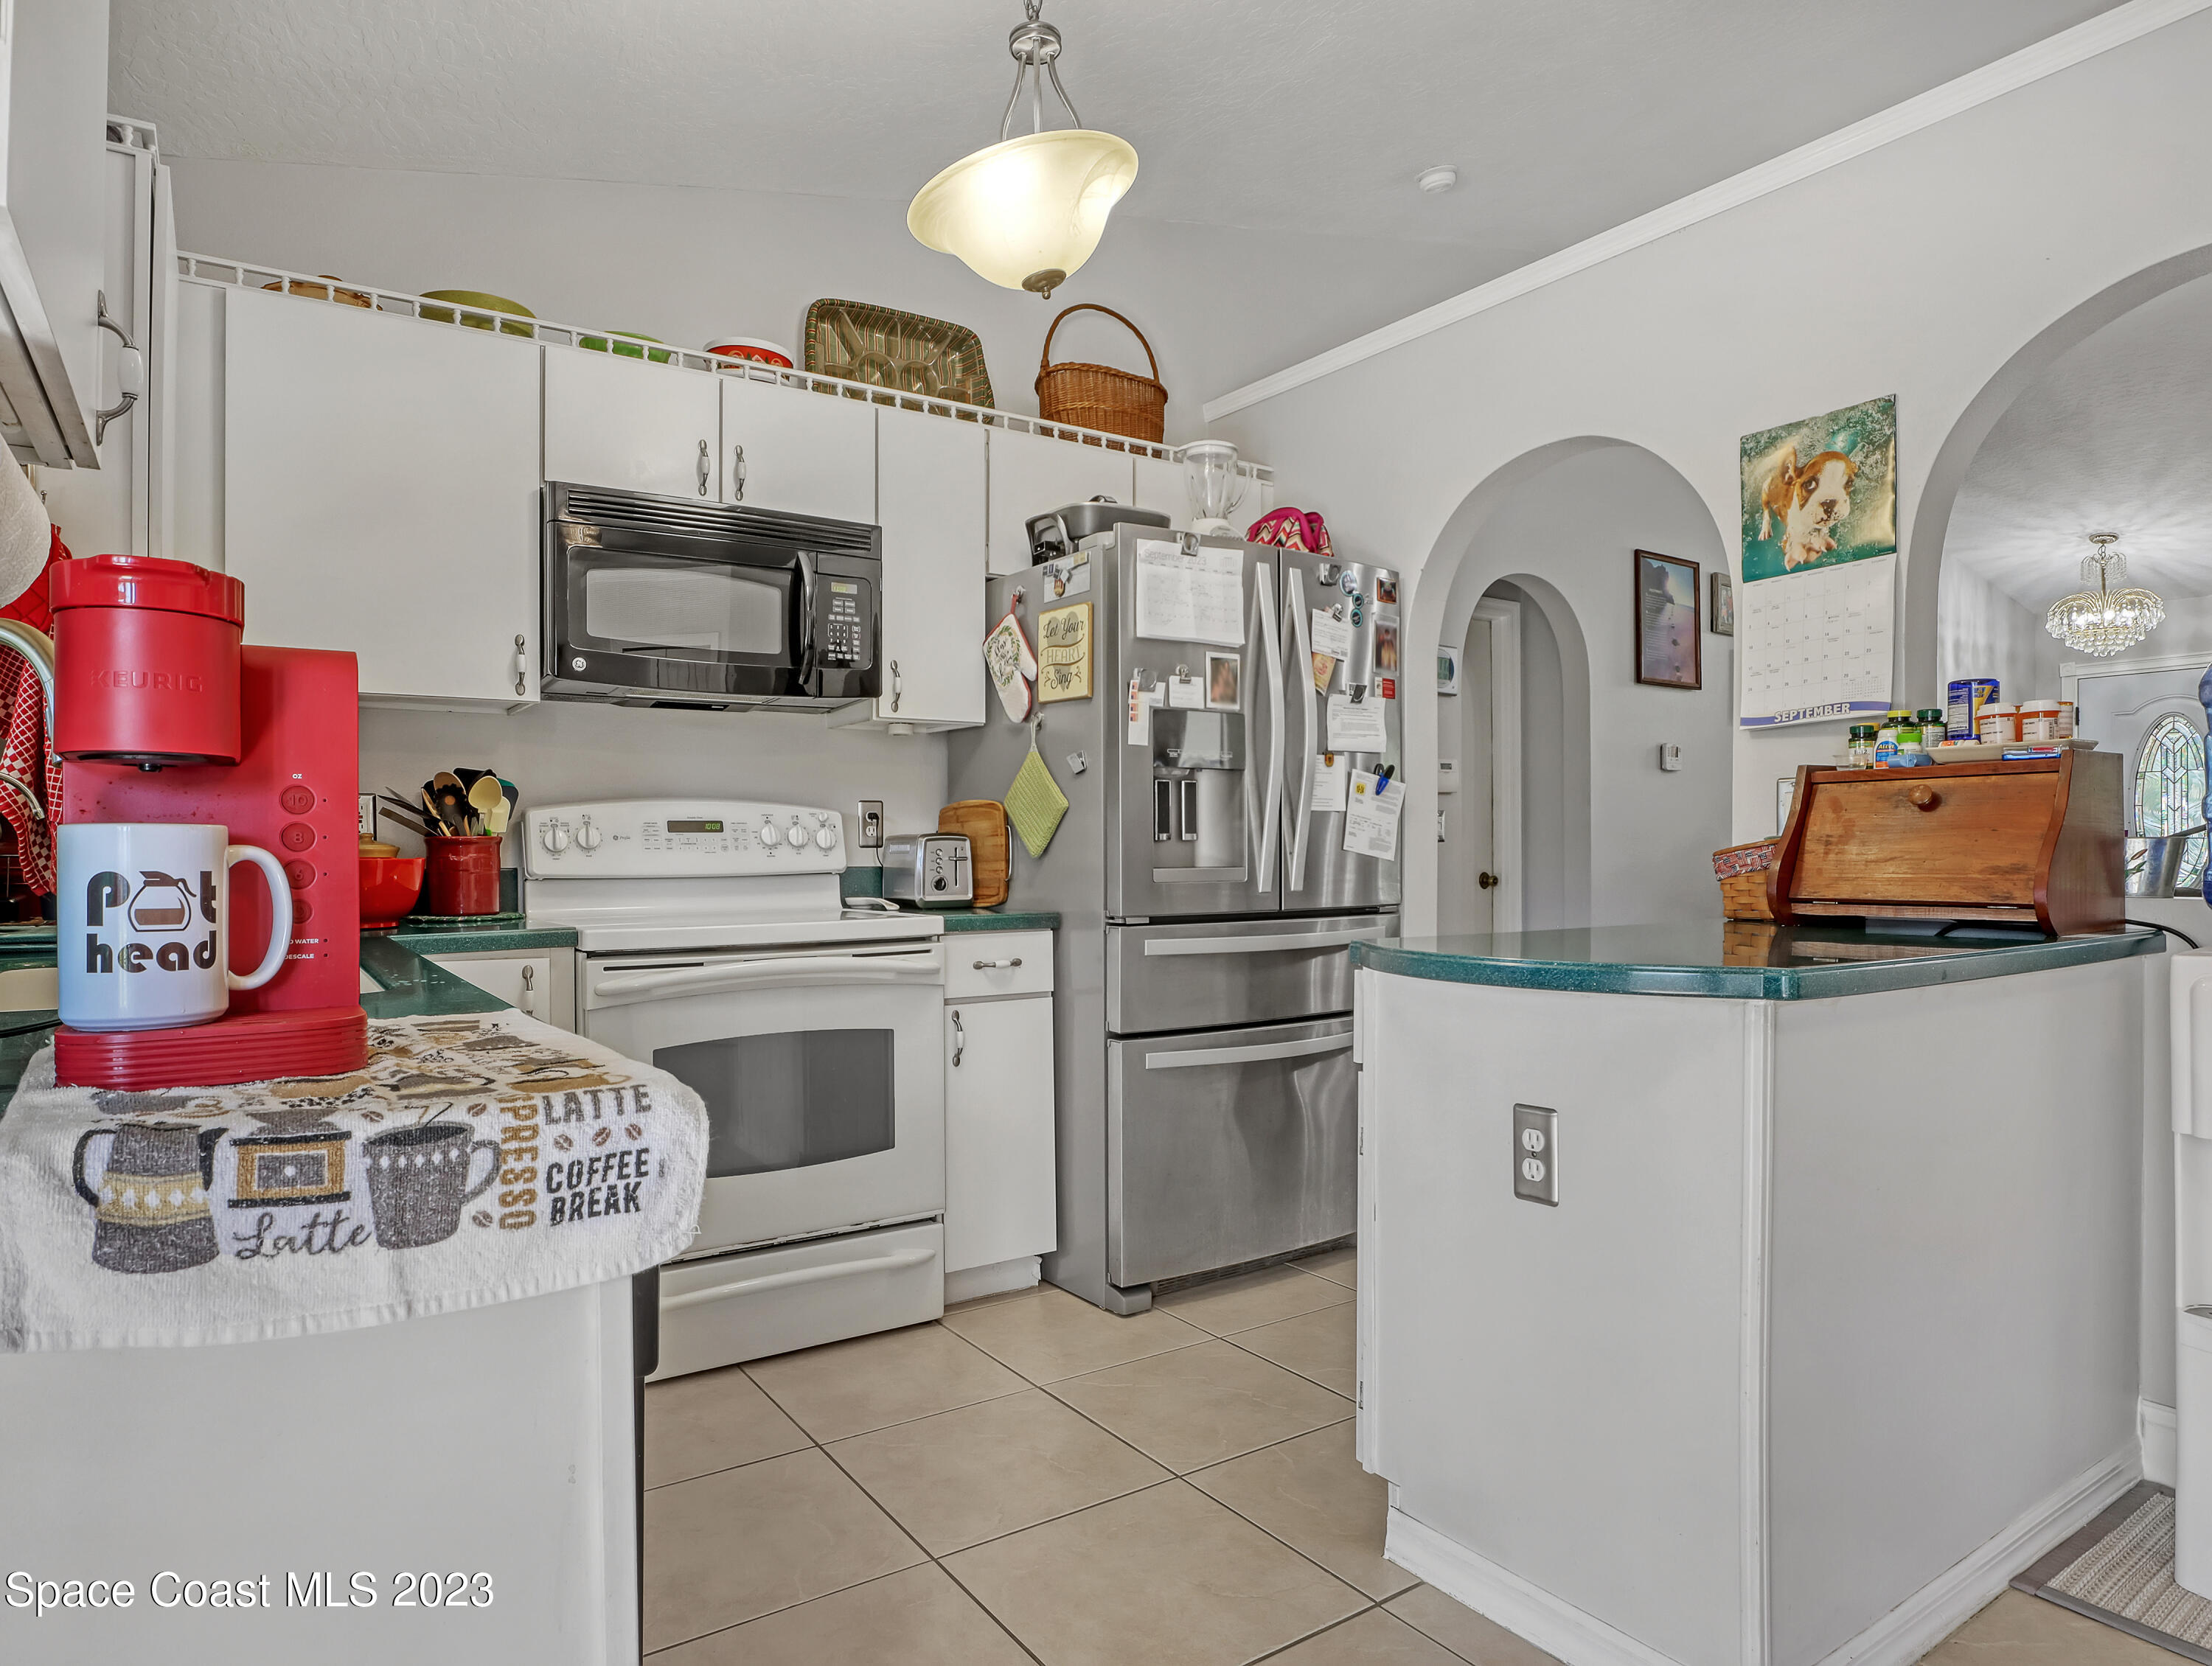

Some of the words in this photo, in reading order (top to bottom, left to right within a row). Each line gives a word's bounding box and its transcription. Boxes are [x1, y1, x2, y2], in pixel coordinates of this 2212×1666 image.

[1144, 548, 1185, 563] September
[1043, 619, 1058, 638] Let
[1061, 618, 1085, 640] Your
[1046, 644, 1082, 663] HEART
[90, 669, 203, 692] KEURIG
[1050, 669, 1074, 689] Sing
[1774, 702, 1851, 722] SEPTEMBER
[289, 793, 309, 807] 10
[294, 831, 304, 844] 8
[295, 868, 304, 881] 6
[86, 930, 217, 973] head
[540, 1084, 652, 1126] LATTE
[546, 1147, 650, 1193] COFFEE
[549, 1180, 642, 1227] BREAK
[232, 1208, 372, 1261] Latte
